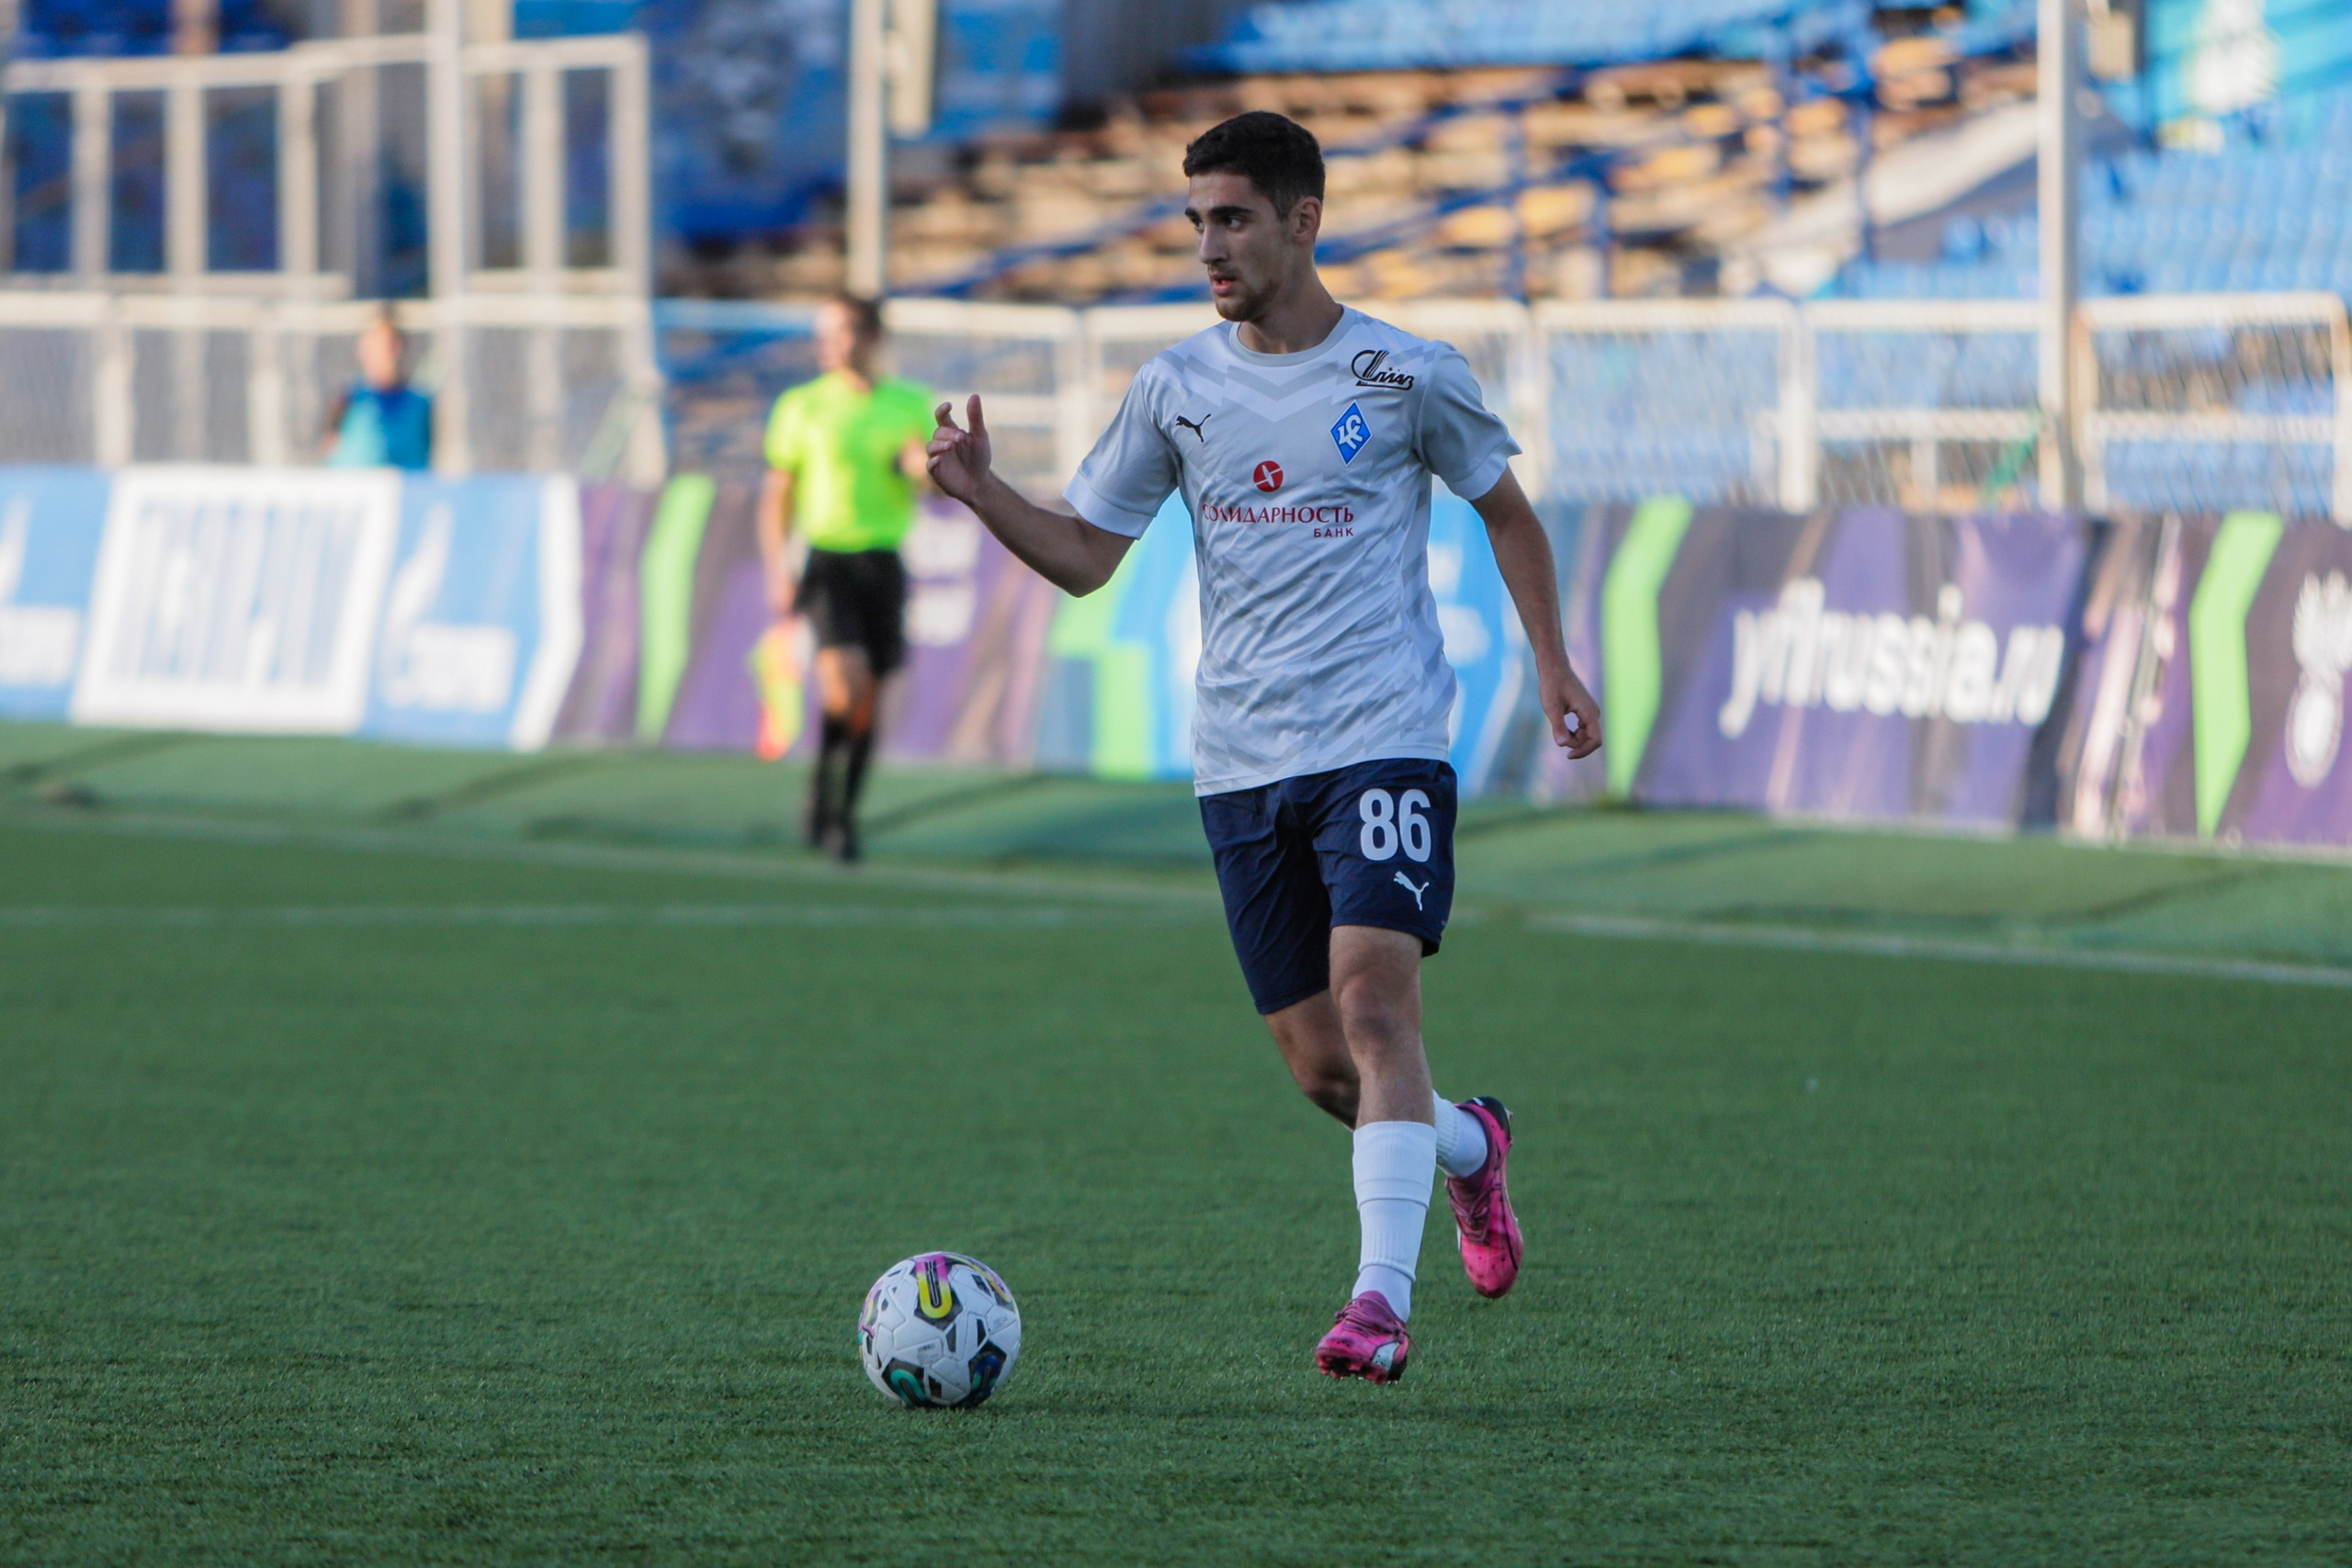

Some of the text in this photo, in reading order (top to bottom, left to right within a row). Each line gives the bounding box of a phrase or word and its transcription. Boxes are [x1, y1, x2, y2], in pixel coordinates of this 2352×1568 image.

[1202, 503, 1354, 525] СОЛИДАРНОСТЬ
[1313, 526, 1354, 538] БАНК
[1359, 787, 1431, 863] 86
